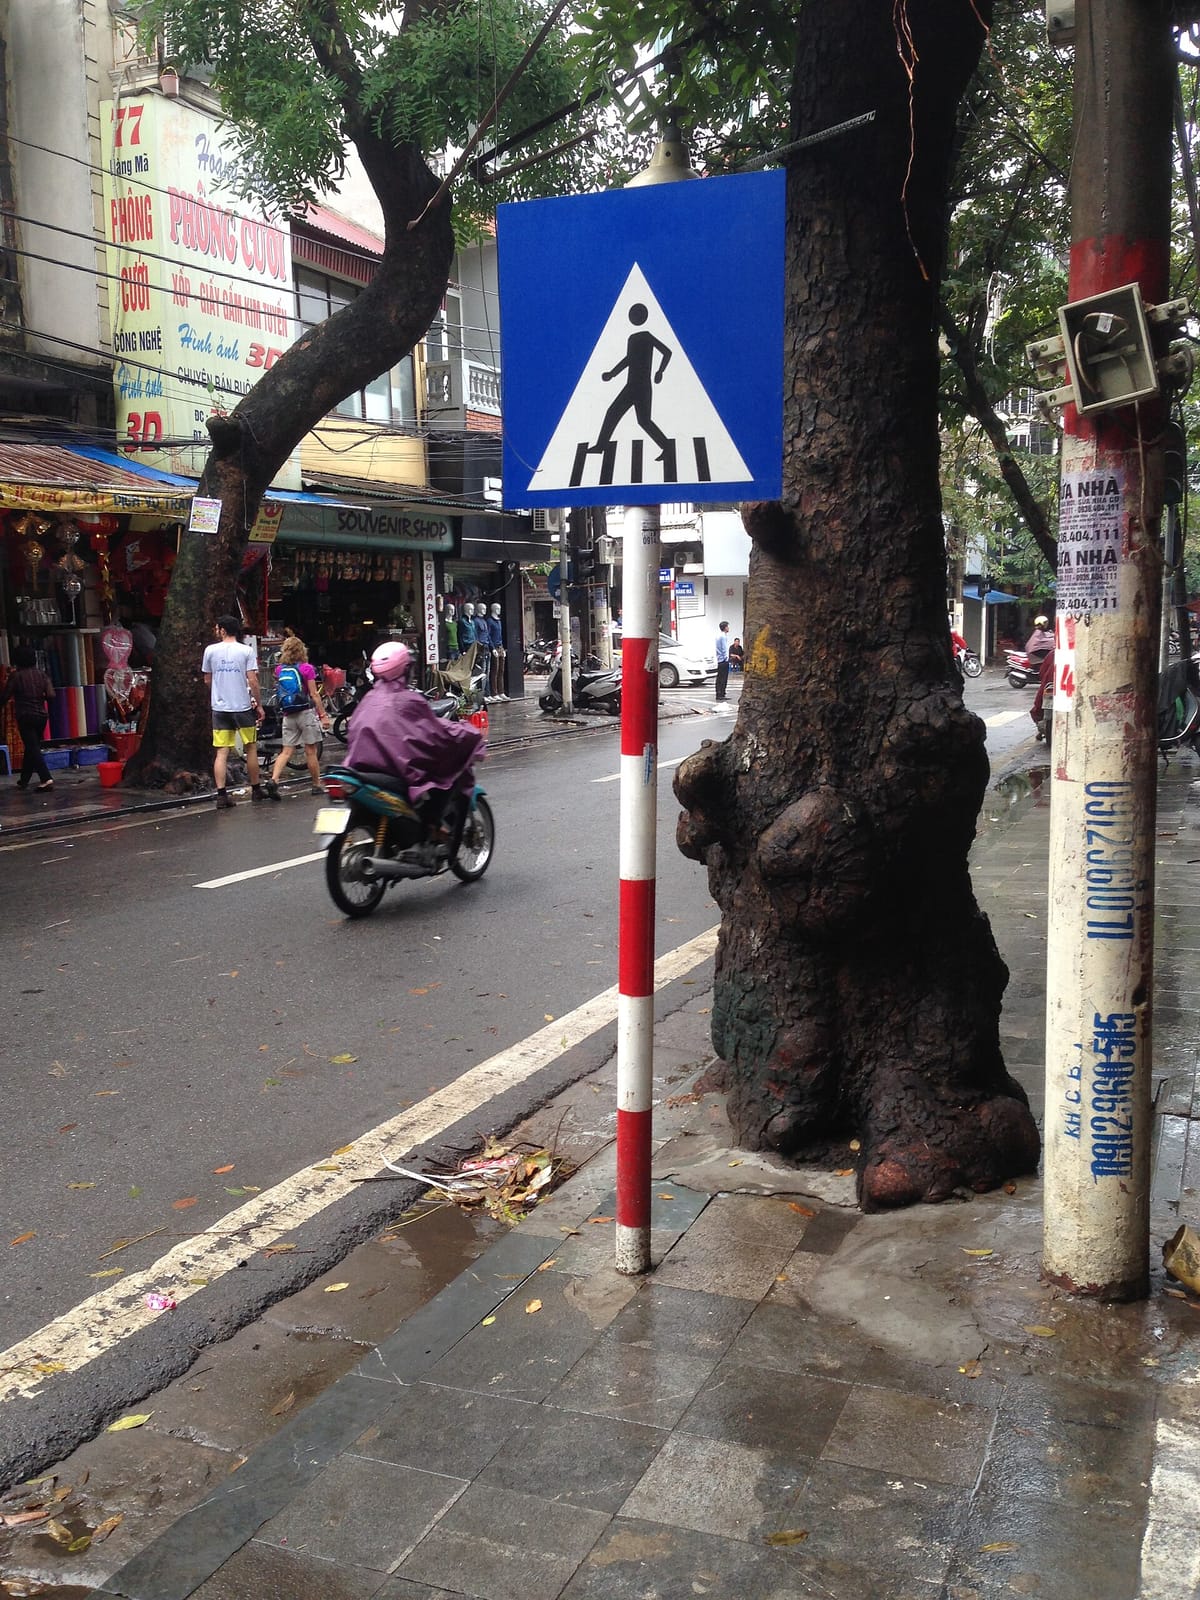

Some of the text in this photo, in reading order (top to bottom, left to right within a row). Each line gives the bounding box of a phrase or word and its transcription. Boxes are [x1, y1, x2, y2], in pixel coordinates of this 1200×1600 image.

[111, 103, 144, 147] 77
[135, 153, 149, 172] Mã
[111, 187, 153, 243] PHÔNG
[168, 179, 237, 264] PHÔNG
[121, 254, 150, 313] CƯỚI
[172, 266, 190, 308] XỐP
[200, 276, 221, 318] GIẤY
[245, 297, 262, 330] KIM
[114, 326, 163, 355] CÔNG NGHỆ
[178, 323, 239, 360] Hình ảnh
[245, 342, 283, 371] 3D
[178, 366, 255, 396] CHUYÊN BÁN BUÔ
[126, 411, 163, 453] 3D
[1078, 475, 1120, 498] NHÀ
[337, 510, 414, 537] SOUVENIR
[414, 518, 448, 540] SHOP
[1076, 545, 1118, 566] NHÀ
[425, 563, 437, 661] CHEAP PRICE
